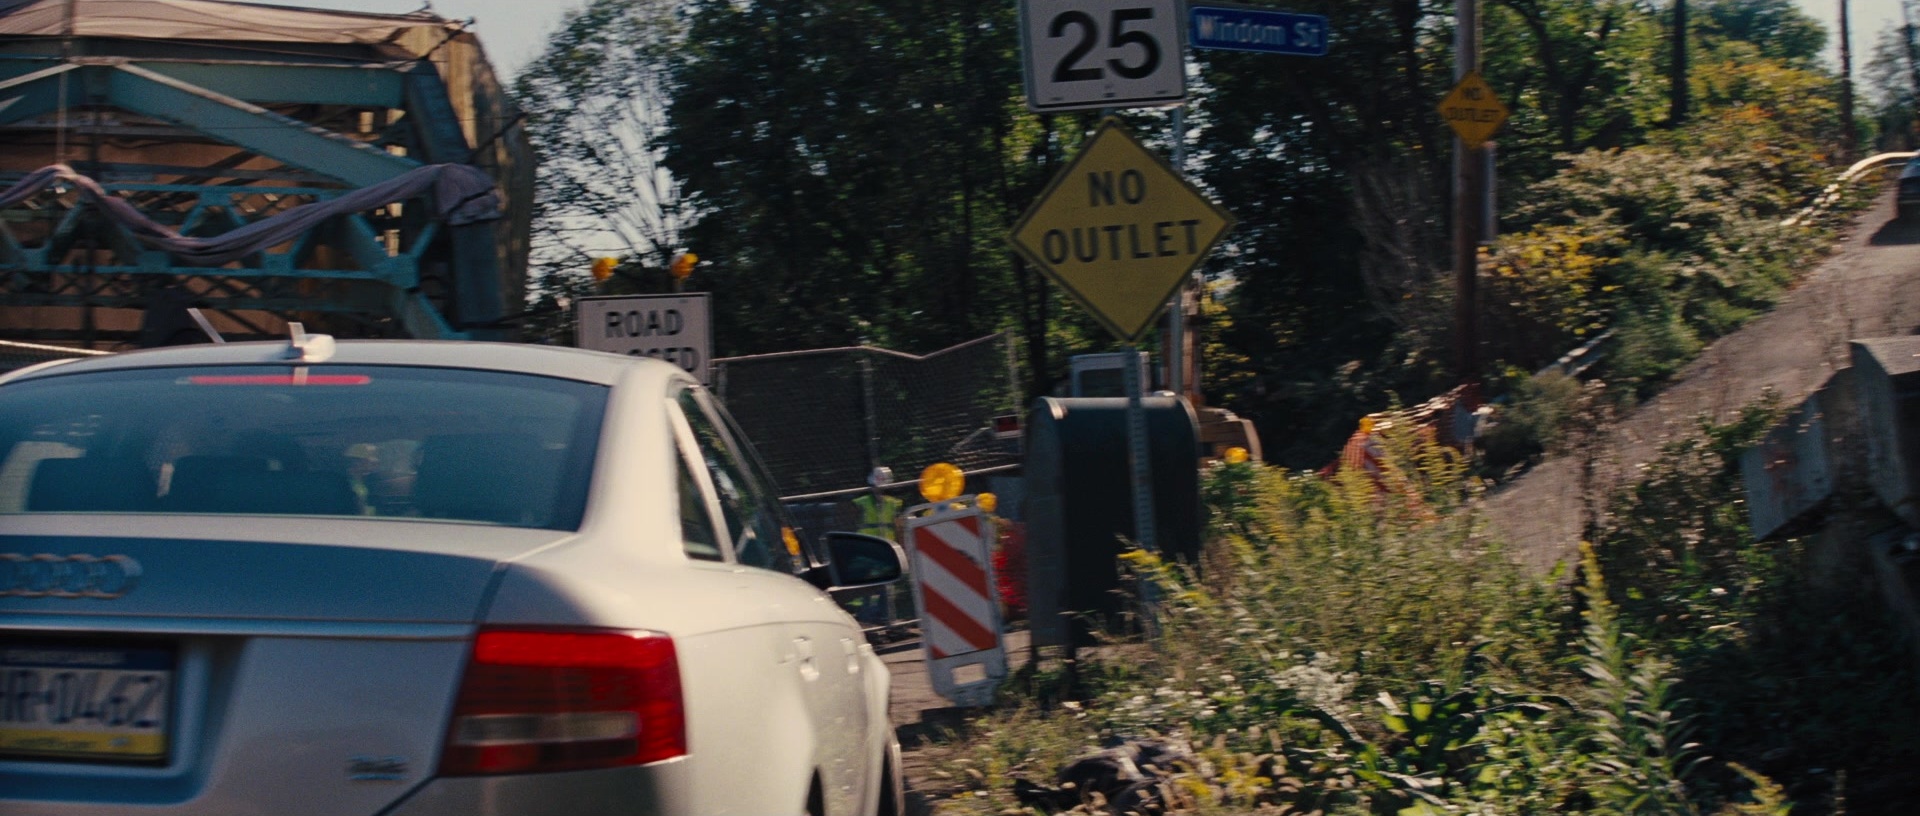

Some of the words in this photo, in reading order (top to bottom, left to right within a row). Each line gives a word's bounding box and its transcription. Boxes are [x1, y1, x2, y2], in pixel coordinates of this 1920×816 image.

[1048, 7, 1161, 83] 25
[1196, 15, 1285, 45] Windom
[1294, 21, 1321, 48] St
[1445, 106, 1500, 123] OUTLET
[1087, 168, 1146, 208] NO
[1042, 218, 1201, 266] OUTLET
[605, 309, 684, 338] ROAD
